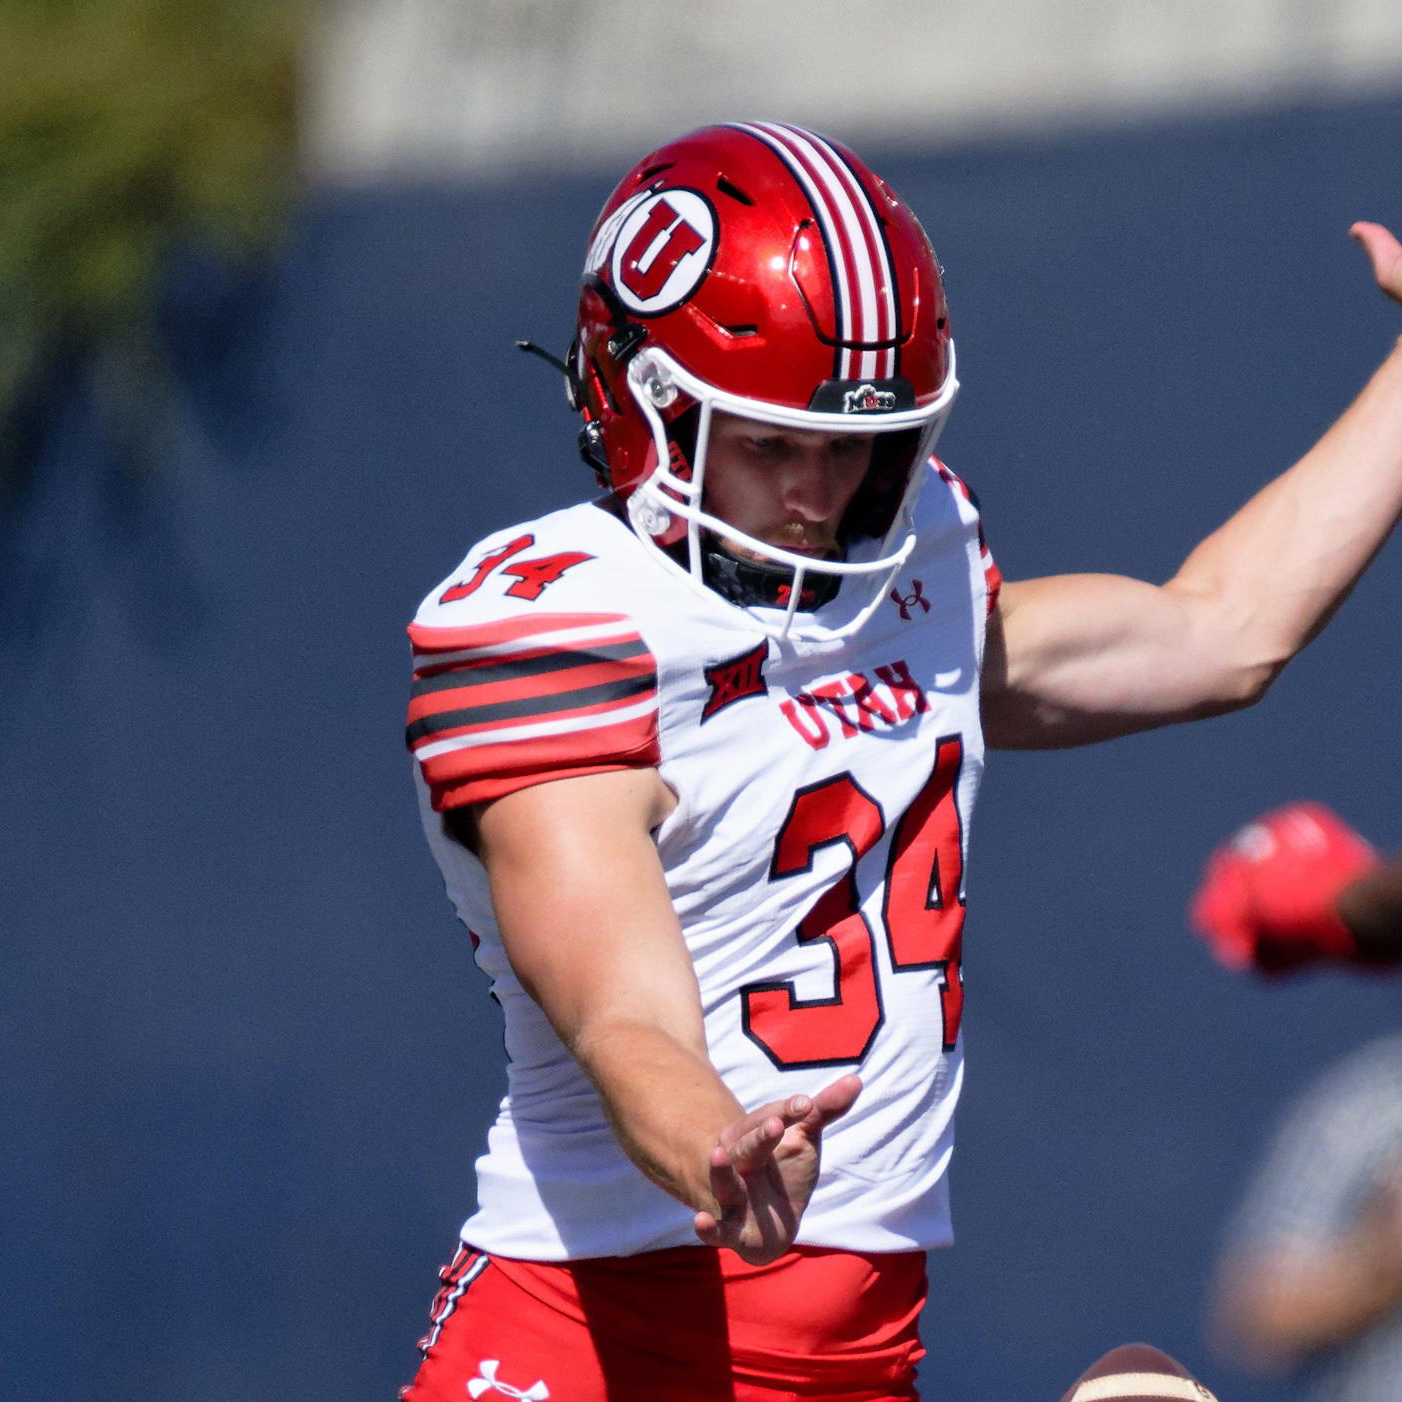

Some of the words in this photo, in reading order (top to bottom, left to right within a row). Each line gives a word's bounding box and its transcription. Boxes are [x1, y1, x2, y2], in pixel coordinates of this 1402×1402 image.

[619, 197, 707, 302] U
[779, 660, 931, 751] UTAH
[739, 732, 967, 1072] 34
